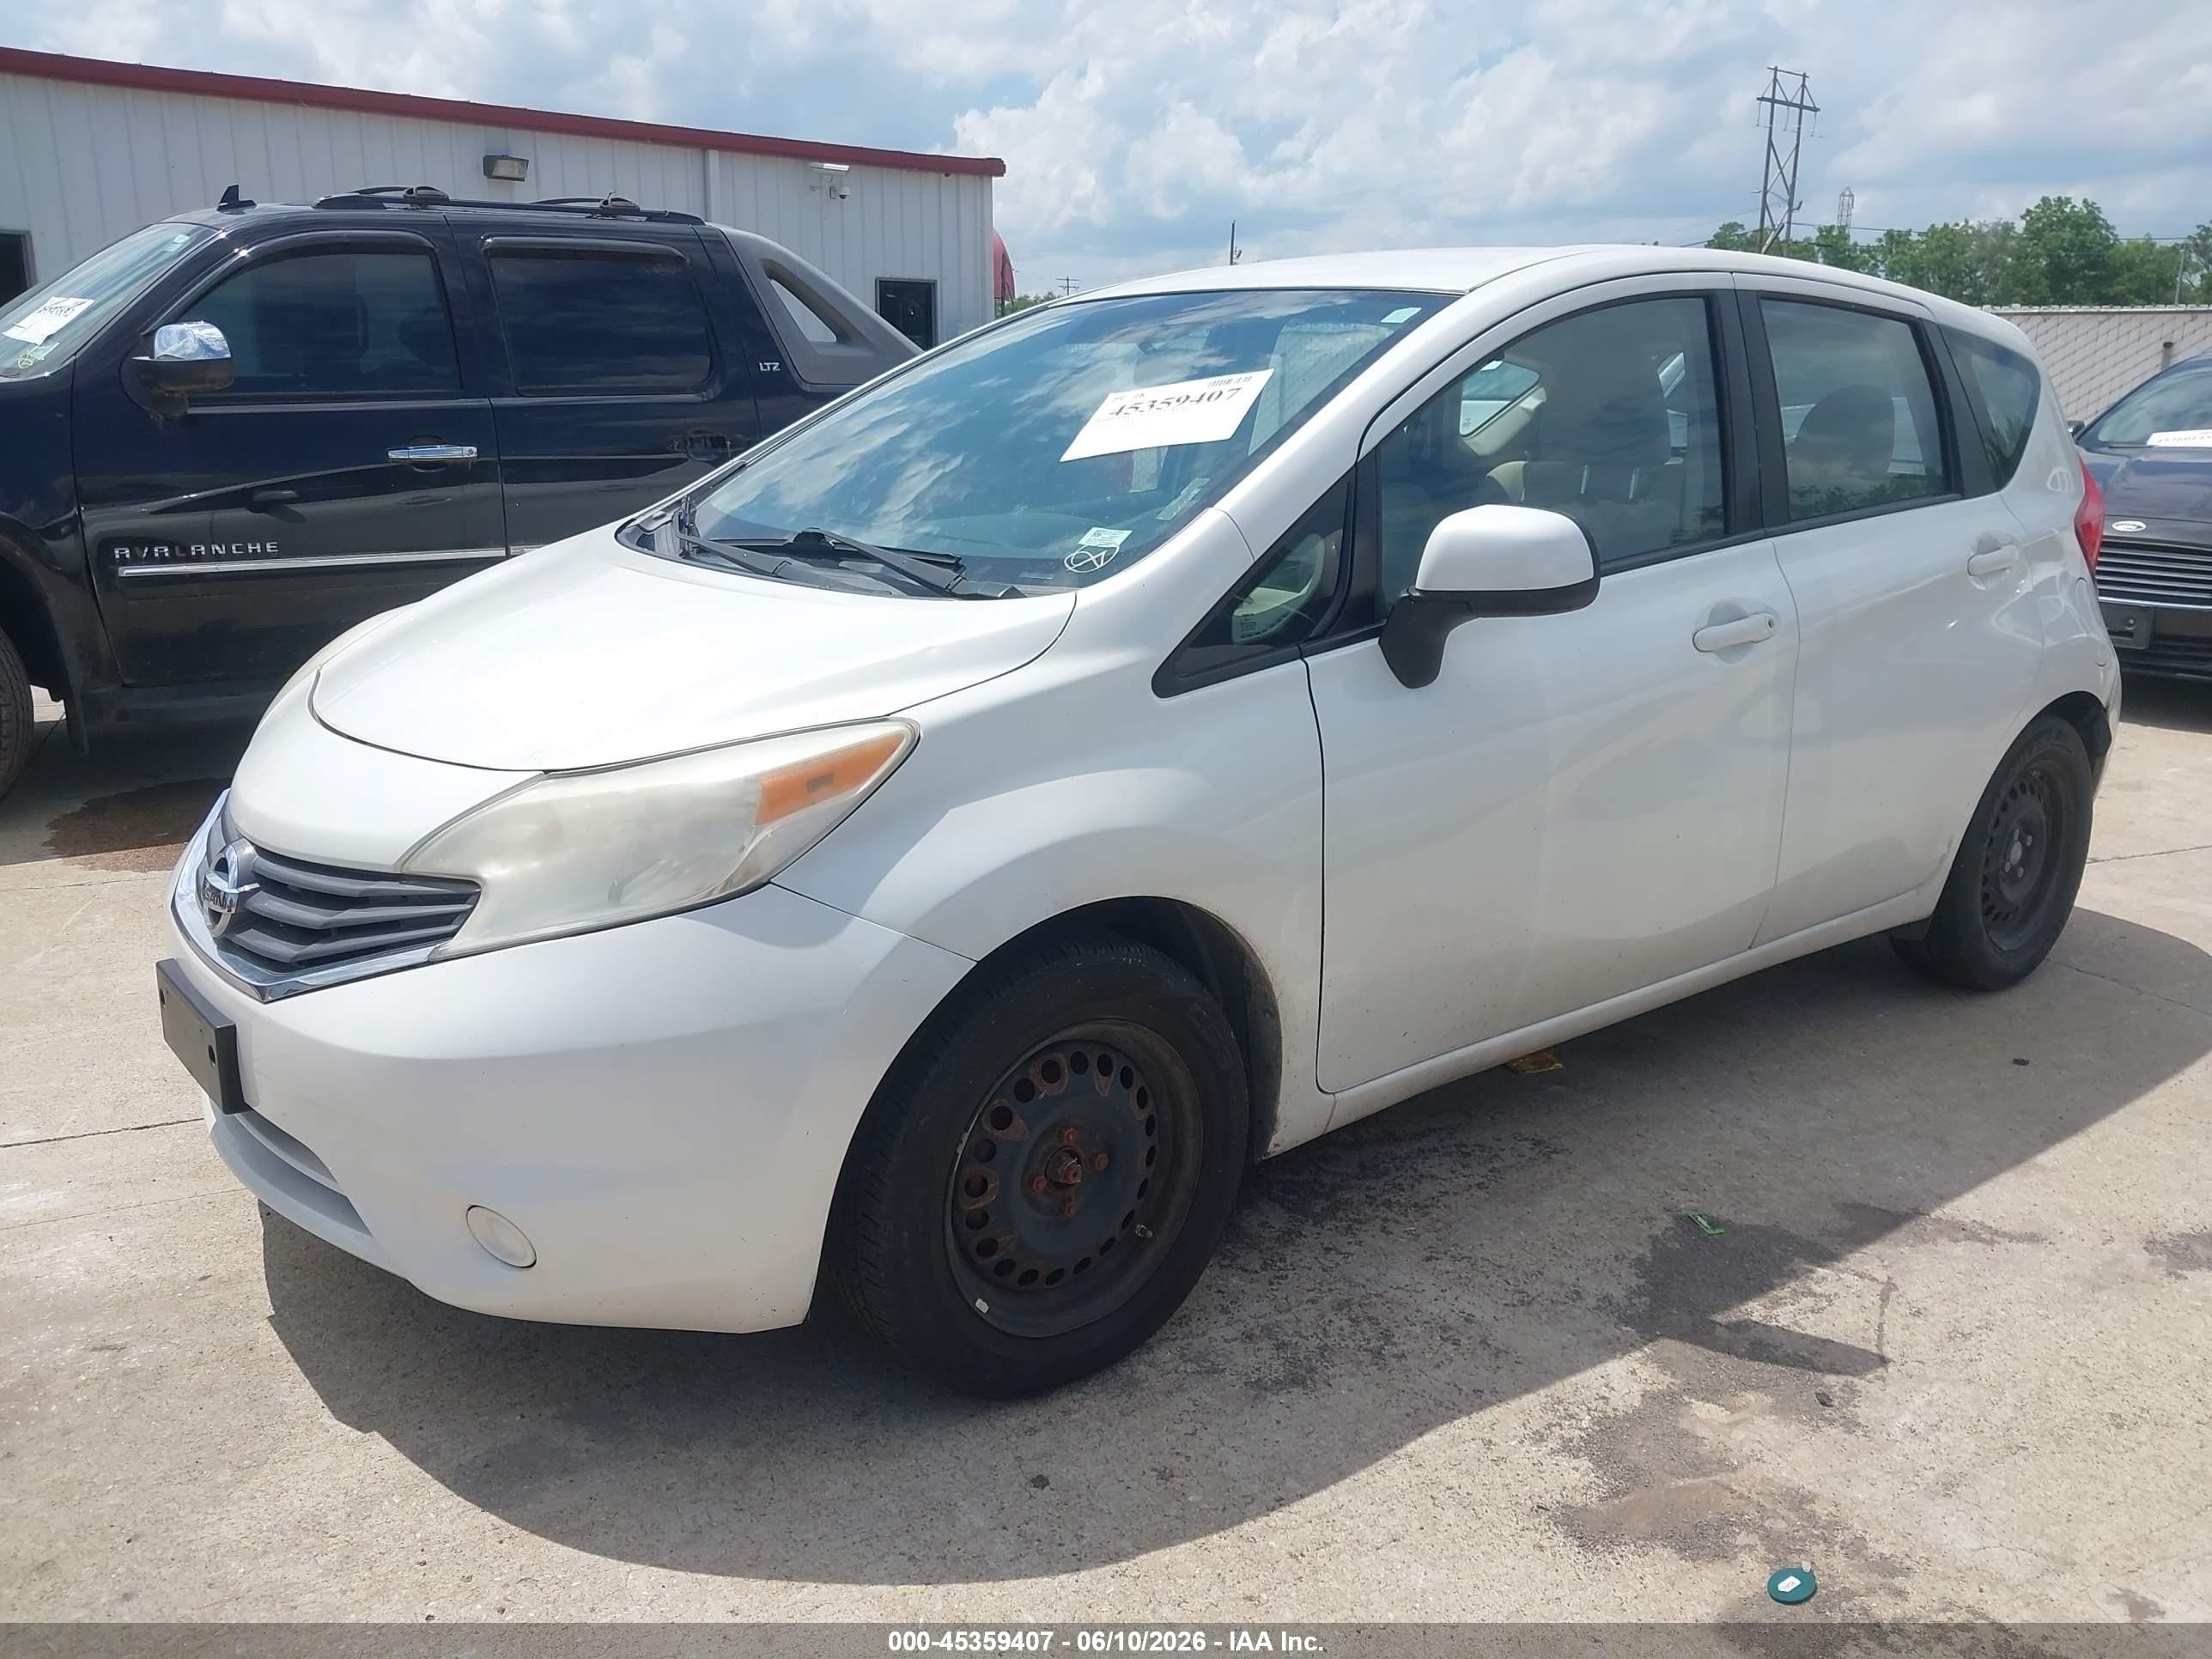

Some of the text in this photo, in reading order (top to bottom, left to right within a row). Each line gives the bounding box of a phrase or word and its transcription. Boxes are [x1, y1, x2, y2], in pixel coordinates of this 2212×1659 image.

[758, 362, 781, 372] LTZ
[1109, 387, 1243, 416] 45359407
[113, 541, 280, 559] AVALANCHE
